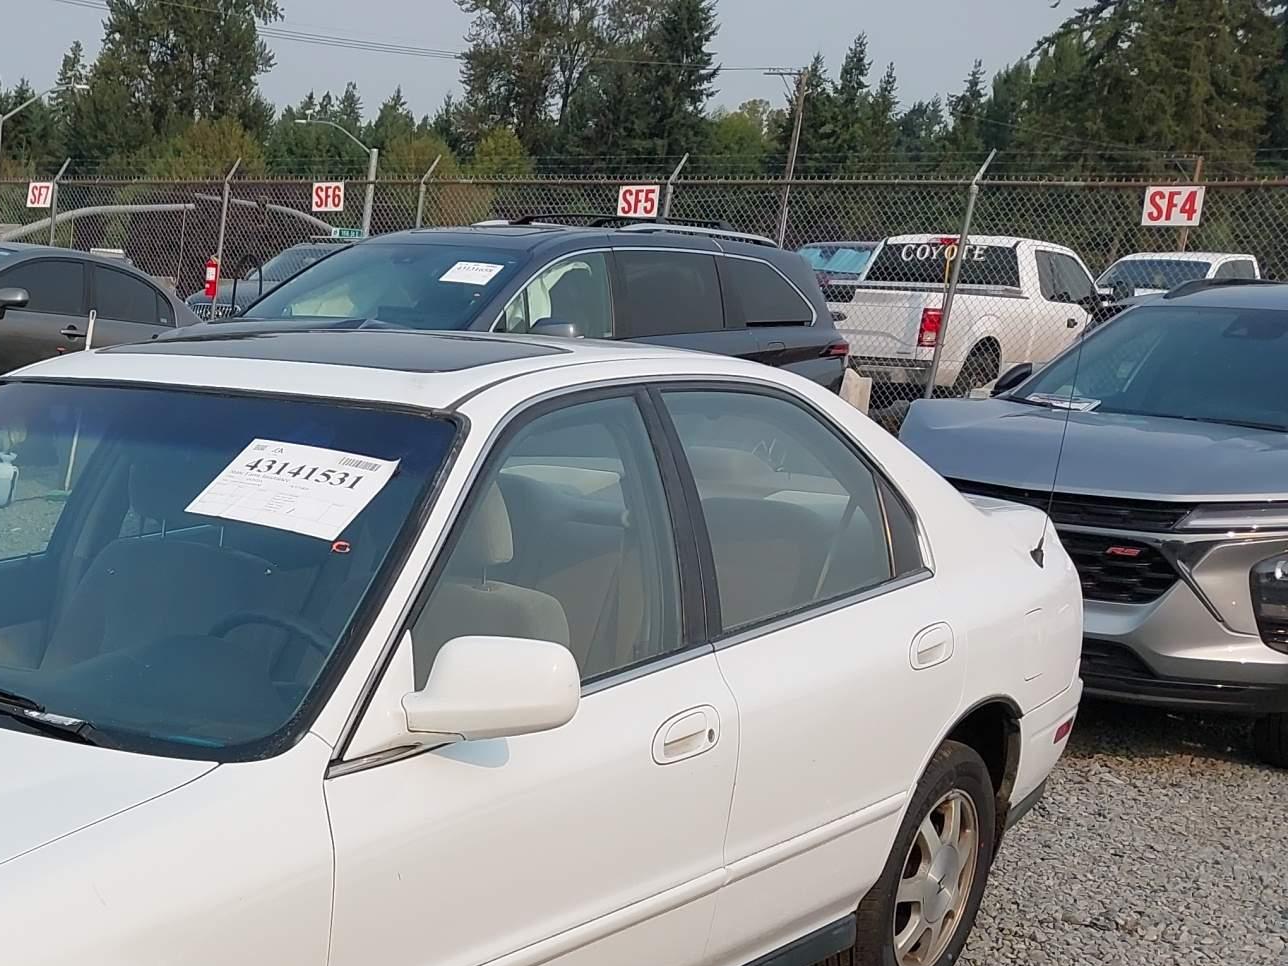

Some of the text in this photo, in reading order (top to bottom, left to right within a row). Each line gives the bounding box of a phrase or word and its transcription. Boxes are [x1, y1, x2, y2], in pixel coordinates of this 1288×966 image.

[30, 185, 50, 205] SF7
[314, 185, 342, 208] SF6
[620, 188, 656, 215] SF5
[1147, 190, 1198, 222] SF4
[901, 244, 988, 261] COYOTE
[245, 457, 364, 490] 43141531
